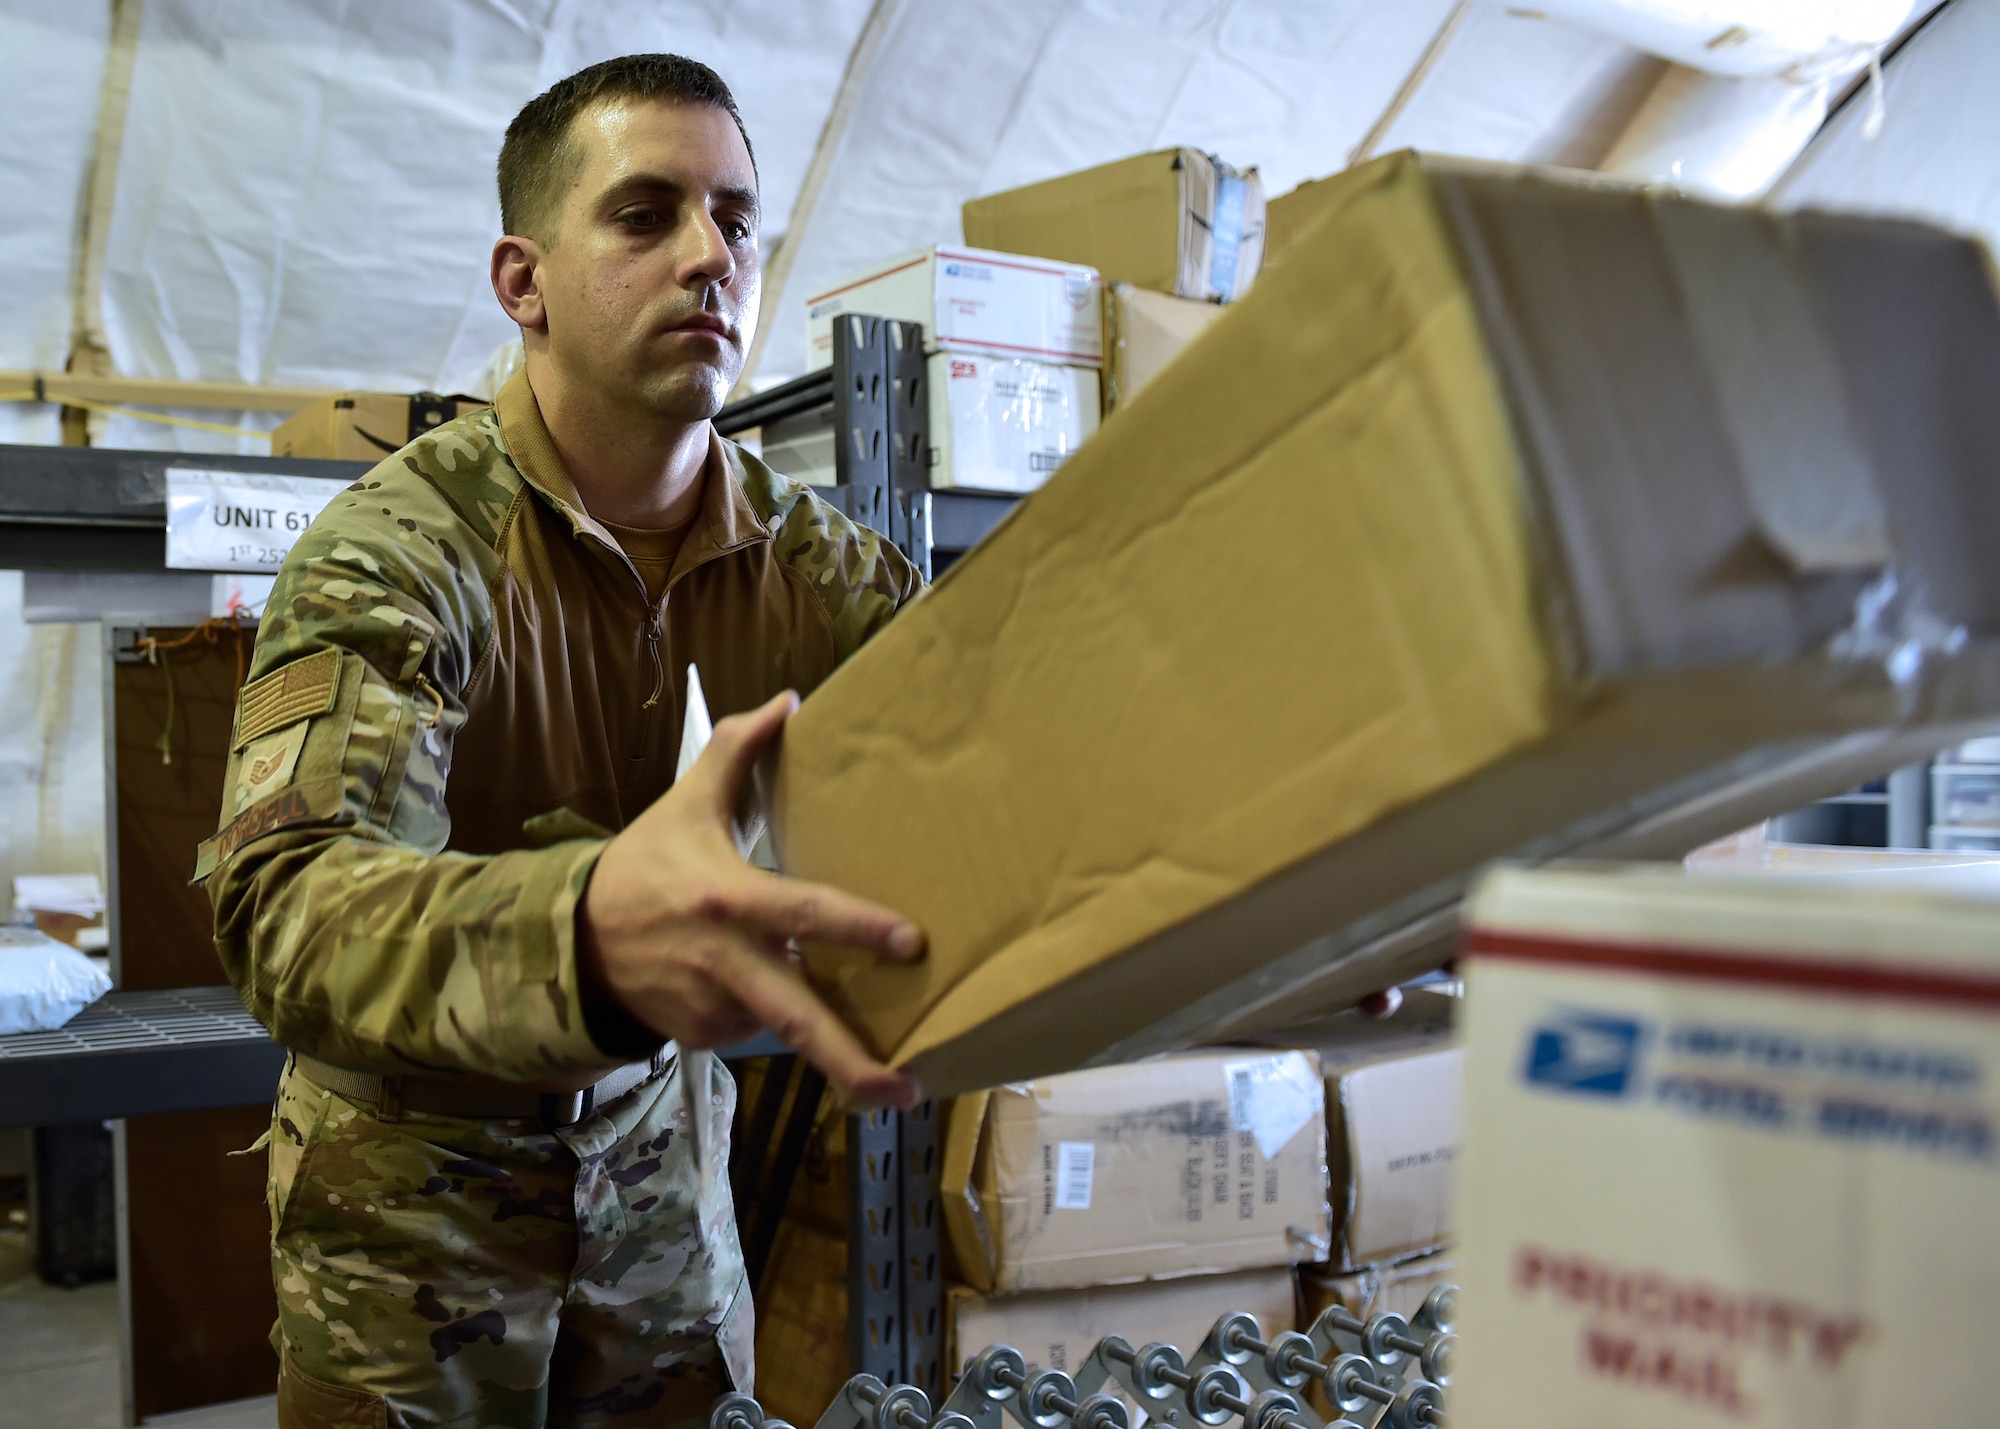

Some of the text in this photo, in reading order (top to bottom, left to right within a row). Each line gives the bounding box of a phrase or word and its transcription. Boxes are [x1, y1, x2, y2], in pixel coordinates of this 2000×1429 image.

[214, 505, 276, 528] UNIT
[1514, 1244, 1876, 1369] PRIORITY
[1582, 1328, 1752, 1420] MAIL
